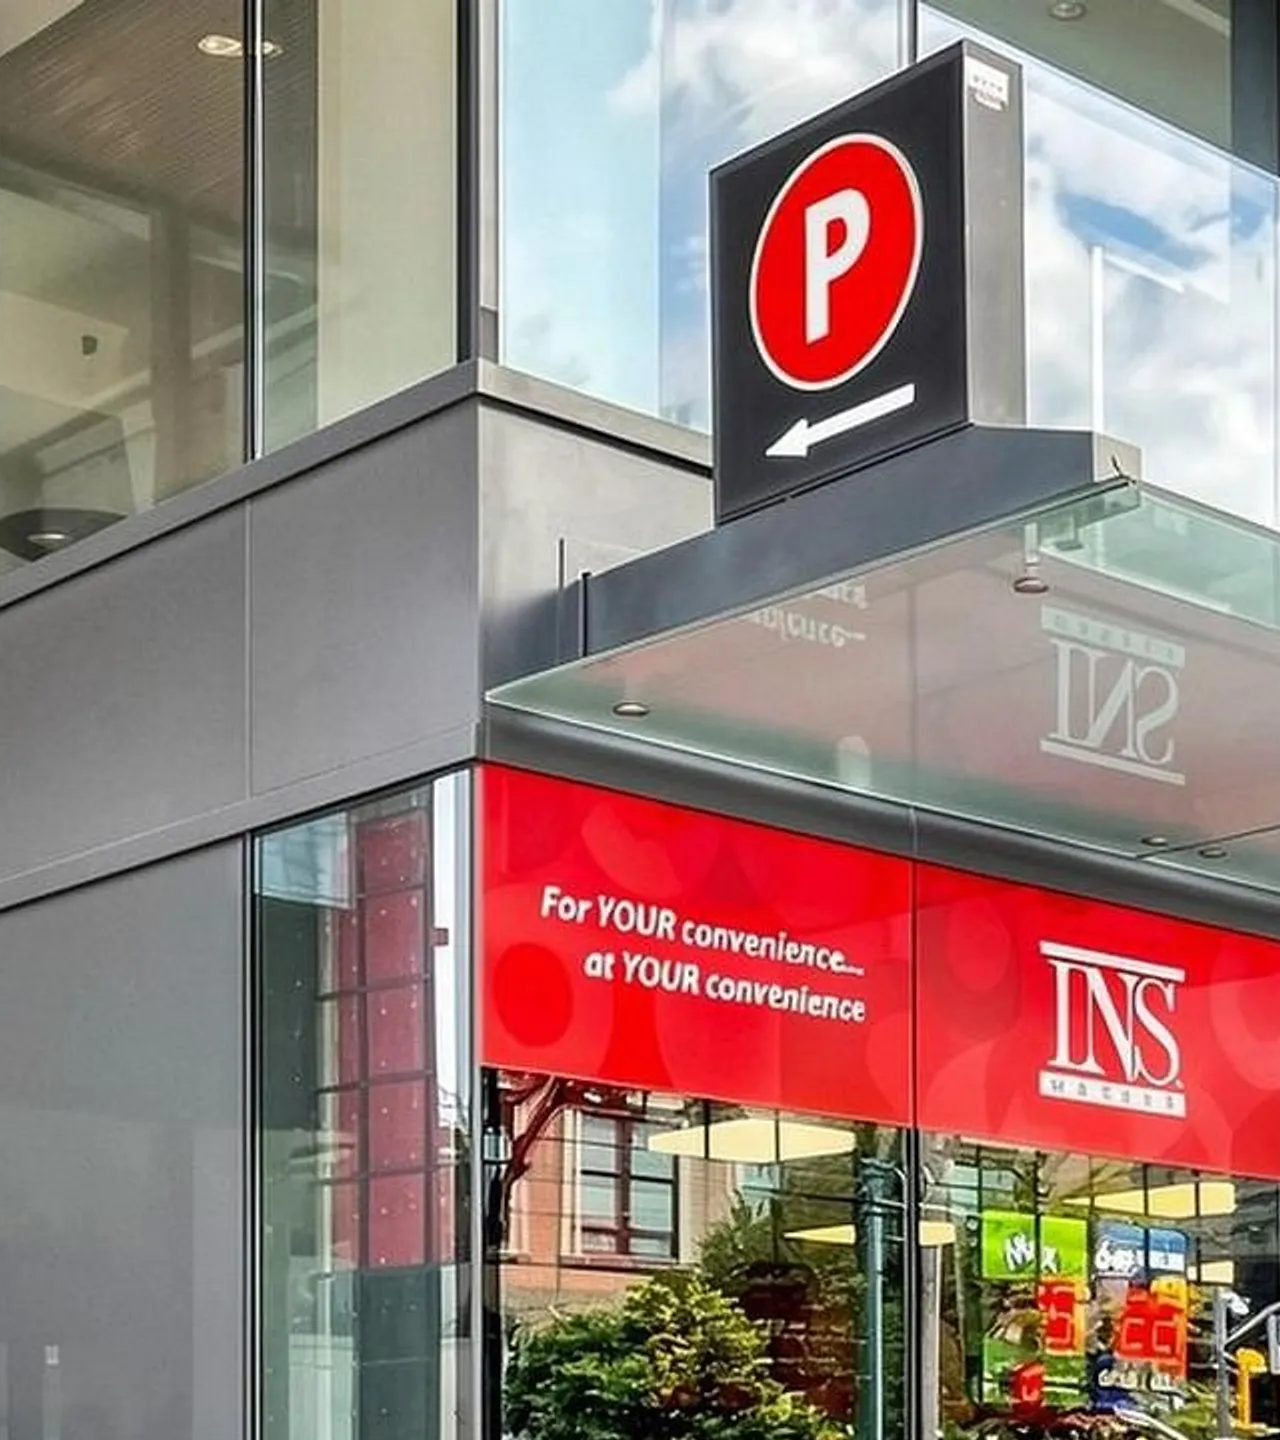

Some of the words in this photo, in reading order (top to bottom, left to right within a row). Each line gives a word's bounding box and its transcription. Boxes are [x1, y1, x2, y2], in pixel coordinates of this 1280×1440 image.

[805, 187, 871, 345] P
[540, 885, 591, 922] For
[597, 895, 676, 942] YOUR
[681, 919, 865, 977] convenience...
[583, 951, 615, 981] at
[621, 952, 700, 996] YOUR
[705, 974, 866, 1023] convenience
[1047, 958, 1183, 1085] INS
